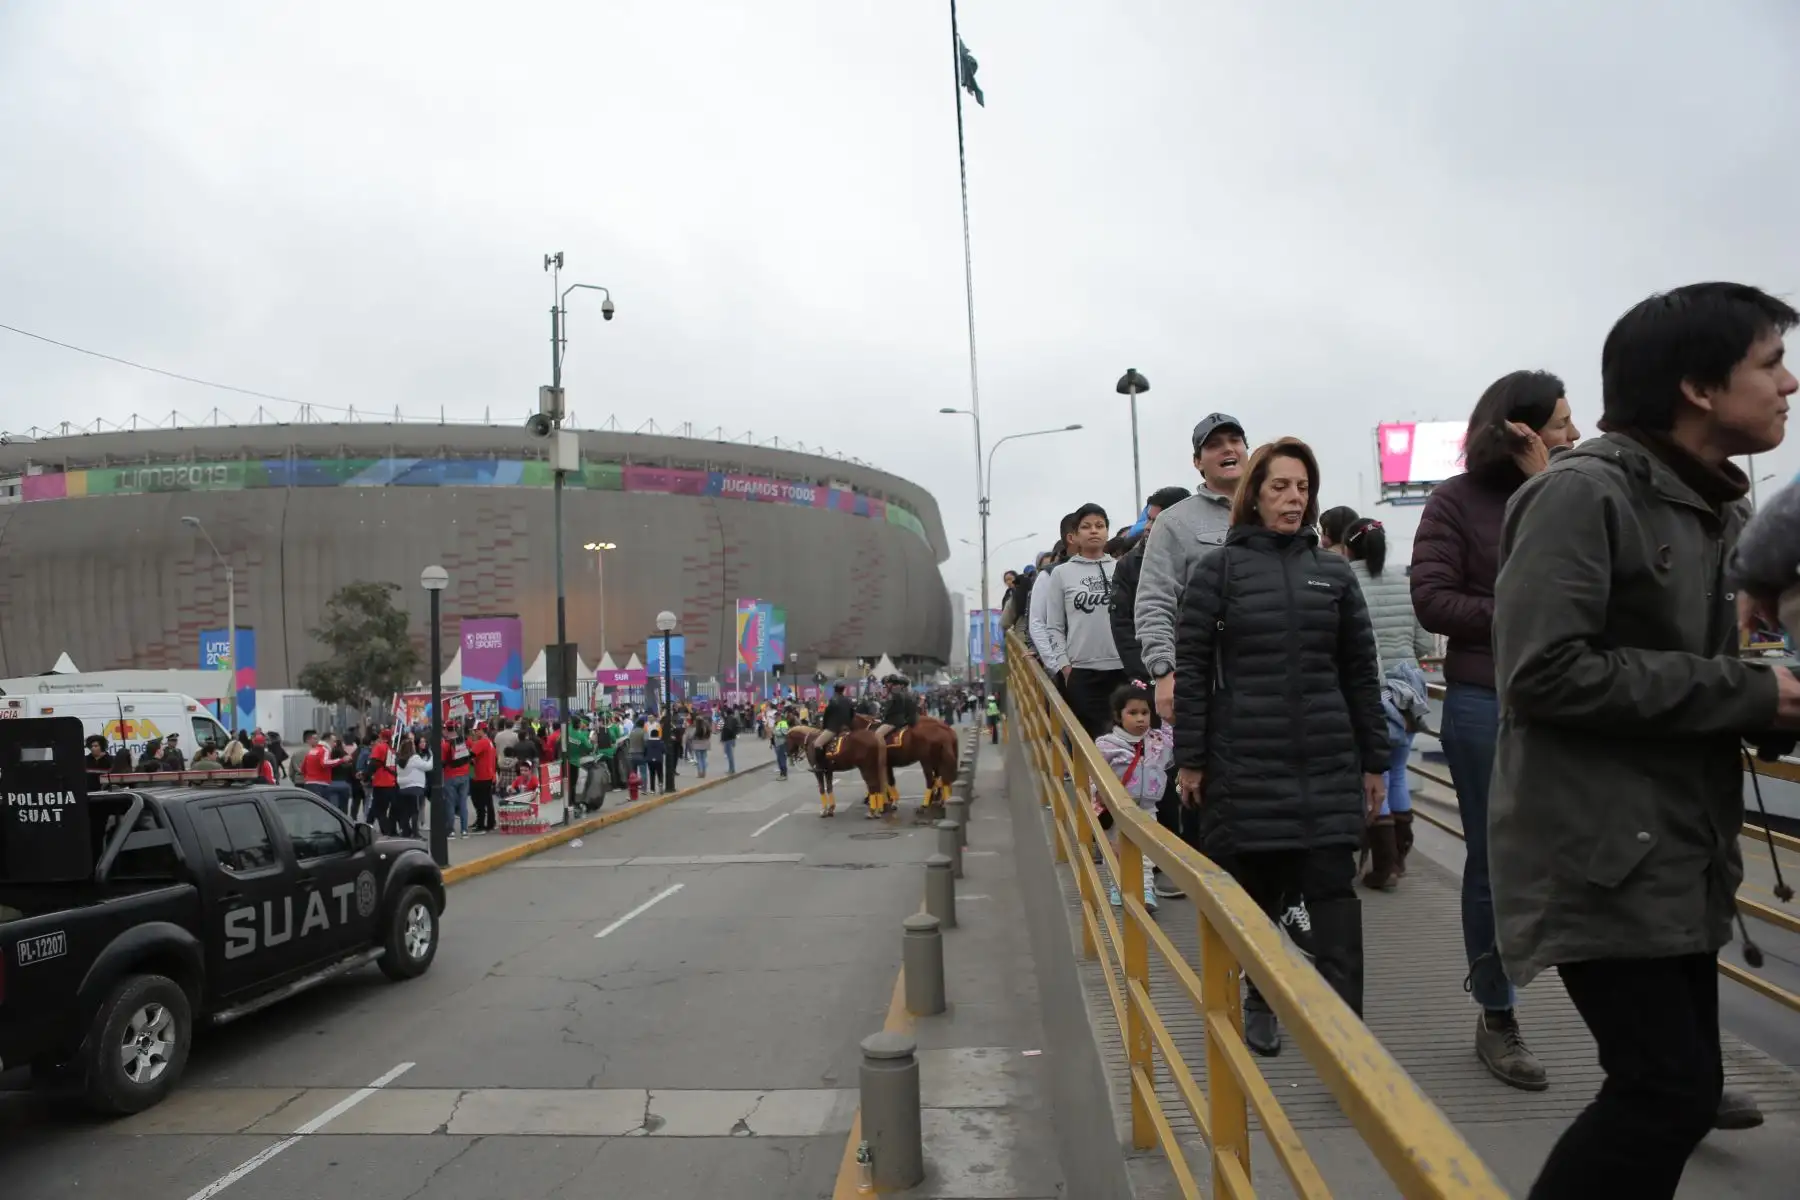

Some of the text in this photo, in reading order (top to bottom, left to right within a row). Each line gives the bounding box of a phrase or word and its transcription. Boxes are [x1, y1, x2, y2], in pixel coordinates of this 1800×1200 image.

[721, 478, 816, 501] JUGAMOS TODOS
[1073, 590, 1110, 614] Que
[7, 791, 77, 806] POLICIA
[18, 808, 64, 823] SUAT
[225, 882, 355, 959] SUAT
[20, 934, 63, 962] PL-12207
